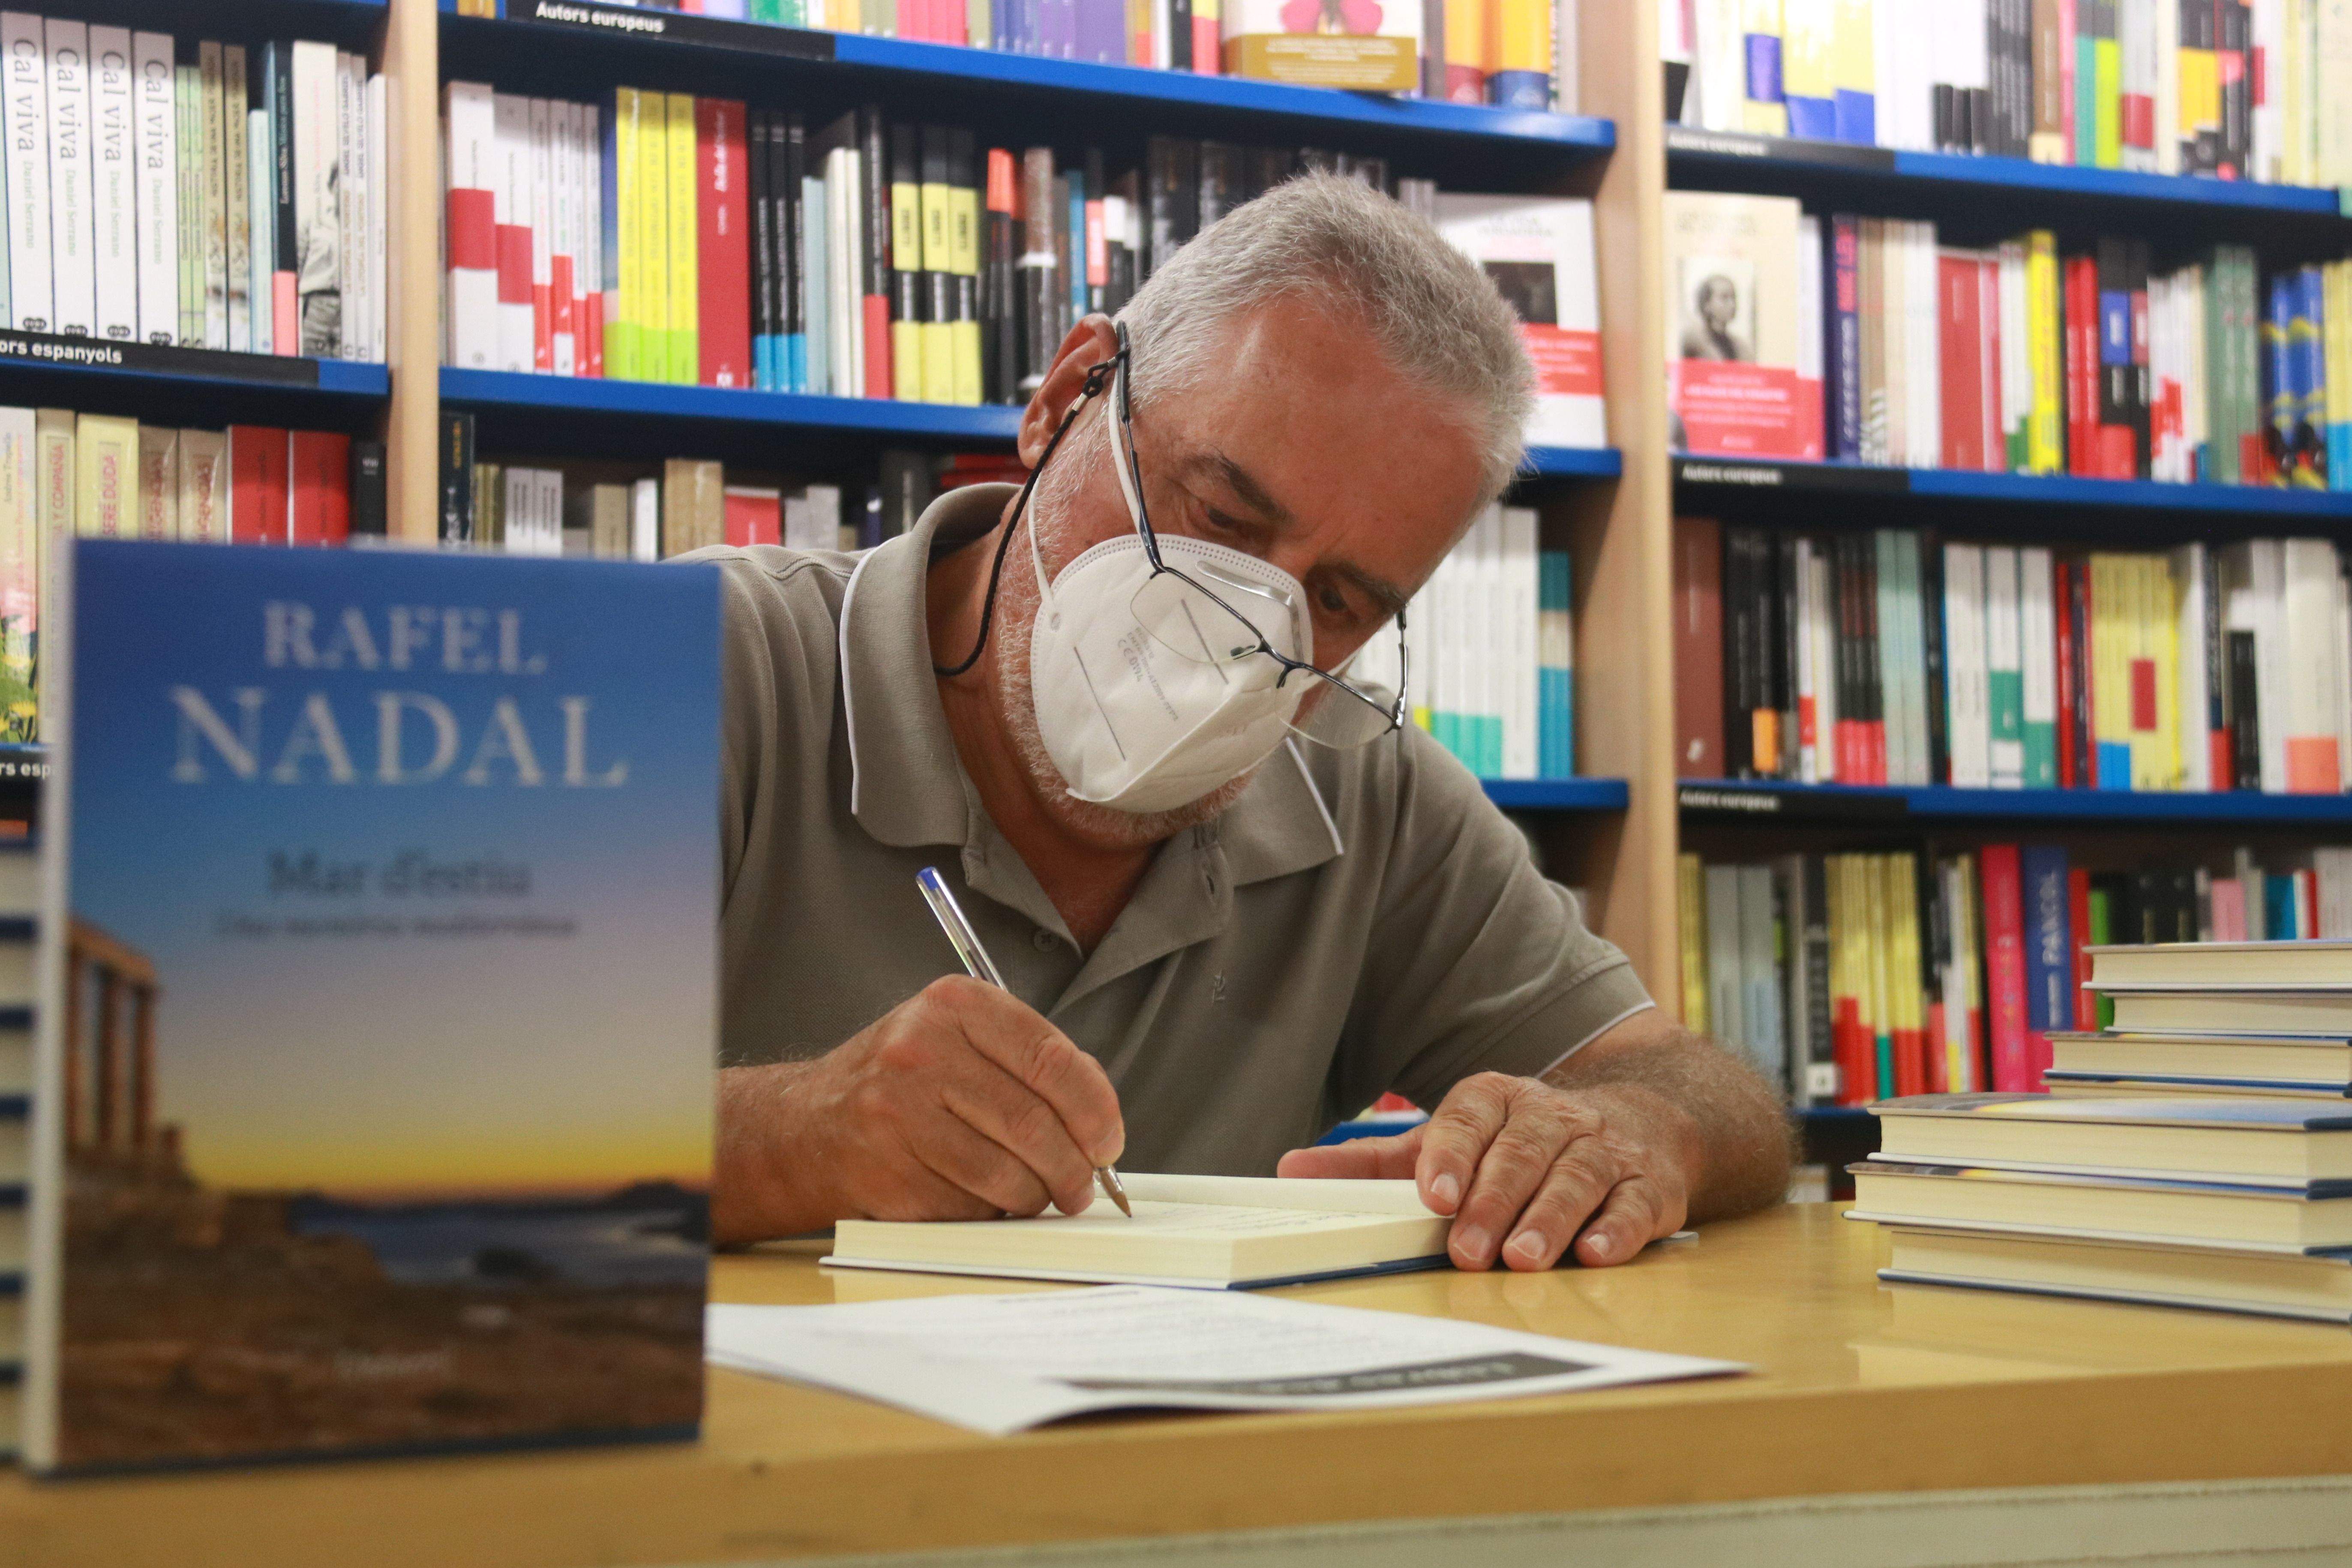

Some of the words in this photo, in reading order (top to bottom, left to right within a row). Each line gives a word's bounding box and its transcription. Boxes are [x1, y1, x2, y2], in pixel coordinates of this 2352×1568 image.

[536, 1, 590, 23] Autors
[591, 11, 664, 33] europeus
[13, 39, 38, 83] Cal
[56, 47, 81, 92] Cal
[102, 51, 126, 95] Cal
[144, 60, 169, 103] Cal
[16, 94, 39, 151] viva
[59, 103, 81, 159] viva
[104, 106, 126, 161] viva
[147, 115, 169, 169] viva
[31, 342, 123, 364] espanyols
[102, 455, 116, 499] DUDA
[263, 600, 548, 676] RAFEL
[170, 684, 631, 789] NADAL
[266, 846, 365, 899] Mar
